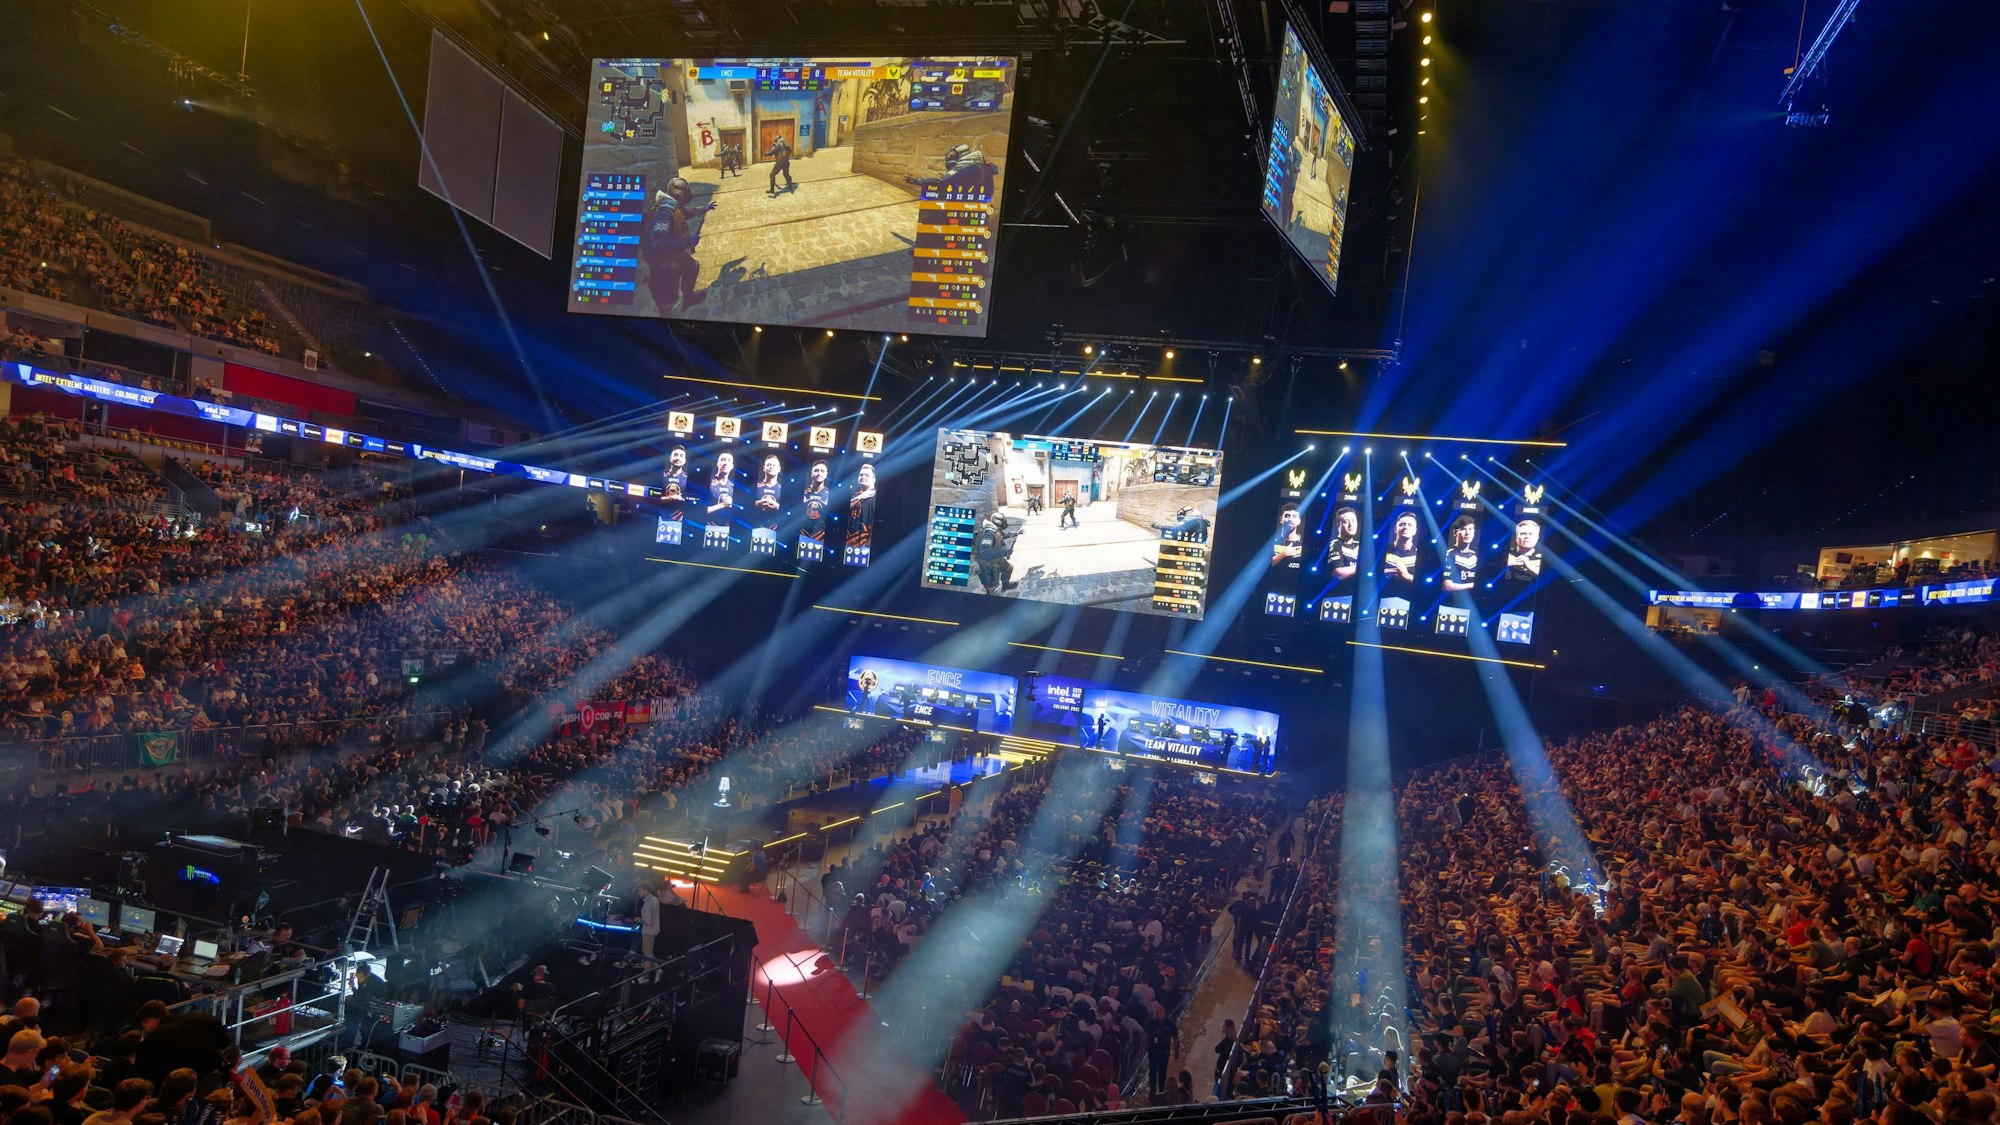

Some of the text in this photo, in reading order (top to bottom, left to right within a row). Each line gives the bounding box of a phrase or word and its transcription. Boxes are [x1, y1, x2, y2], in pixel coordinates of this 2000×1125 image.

[701, 130, 714, 148] B
[56, 378, 83, 390] EXTREME
[84, 384, 111, 395] MASTERS
[115, 391, 140, 401] COLOGNE
[140, 394, 155, 404] 2023
[1092, 470, 1100, 480] A
[1014, 484, 1023, 494] B
[927, 669, 963, 690] ENCE
[1048, 685, 1069, 696] intel
[914, 705, 933, 715] ENCE
[1152, 700, 1220, 727] VITALITY
[1145, 740, 1202, 756] TEAM VITALITY
